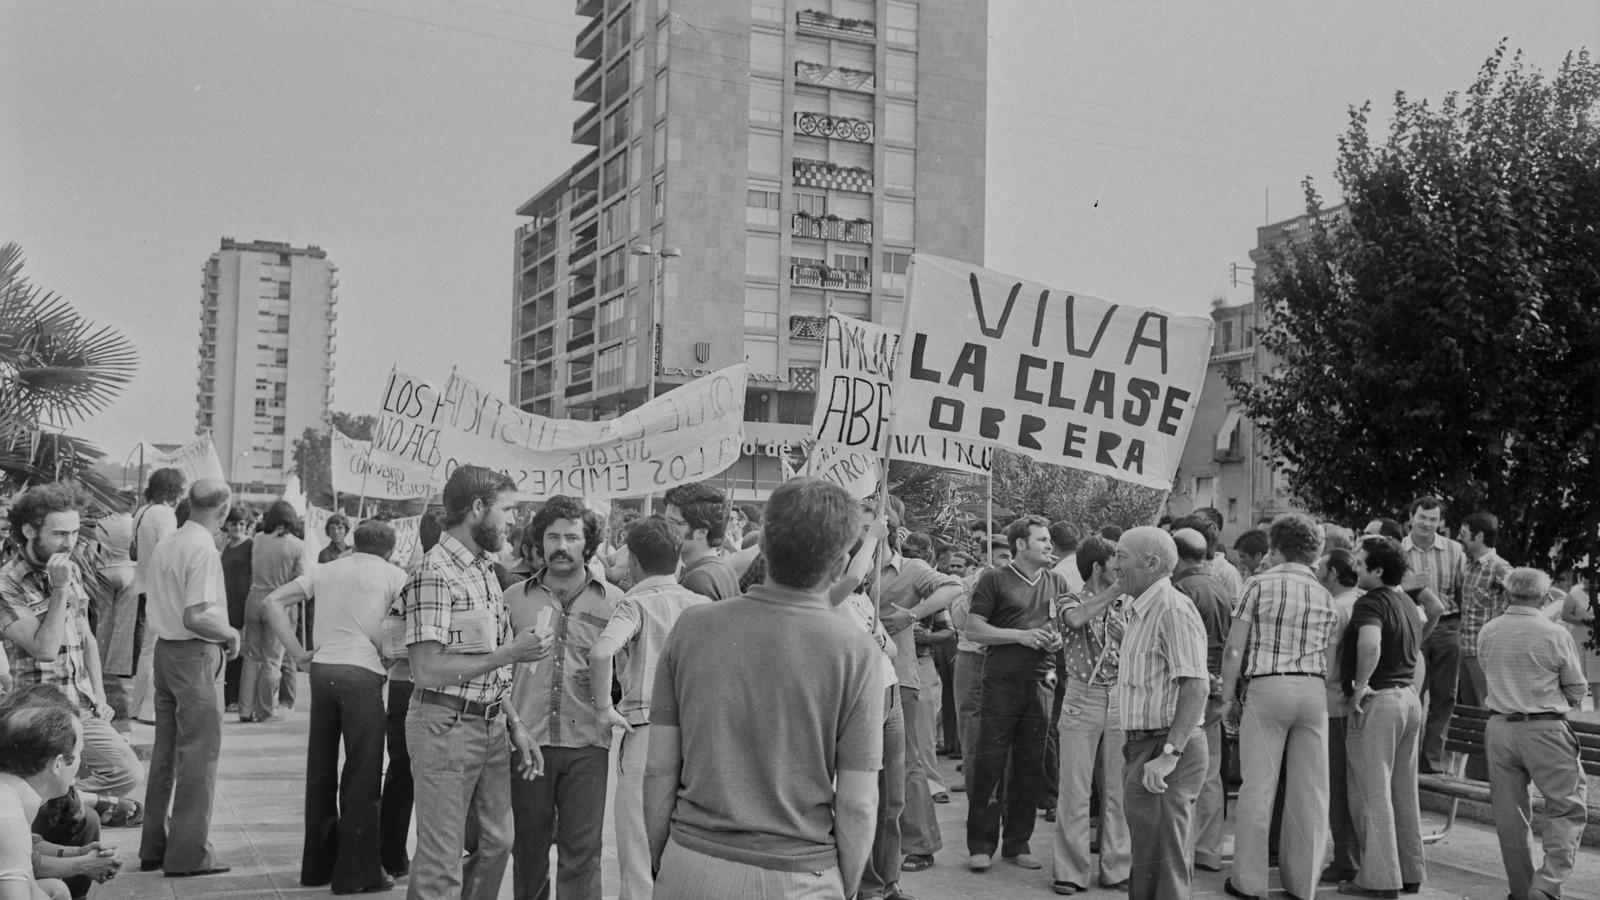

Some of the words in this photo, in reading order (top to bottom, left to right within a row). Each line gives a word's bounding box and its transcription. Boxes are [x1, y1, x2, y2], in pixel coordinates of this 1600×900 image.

[969, 272, 1168, 375] VIVA
[383, 374, 431, 418] LOS
[910, 333, 987, 393] LA
[1014, 353, 1191, 436] CLASE
[375, 414, 404, 451] NO
[929, 396, 1145, 475] OBRERA
